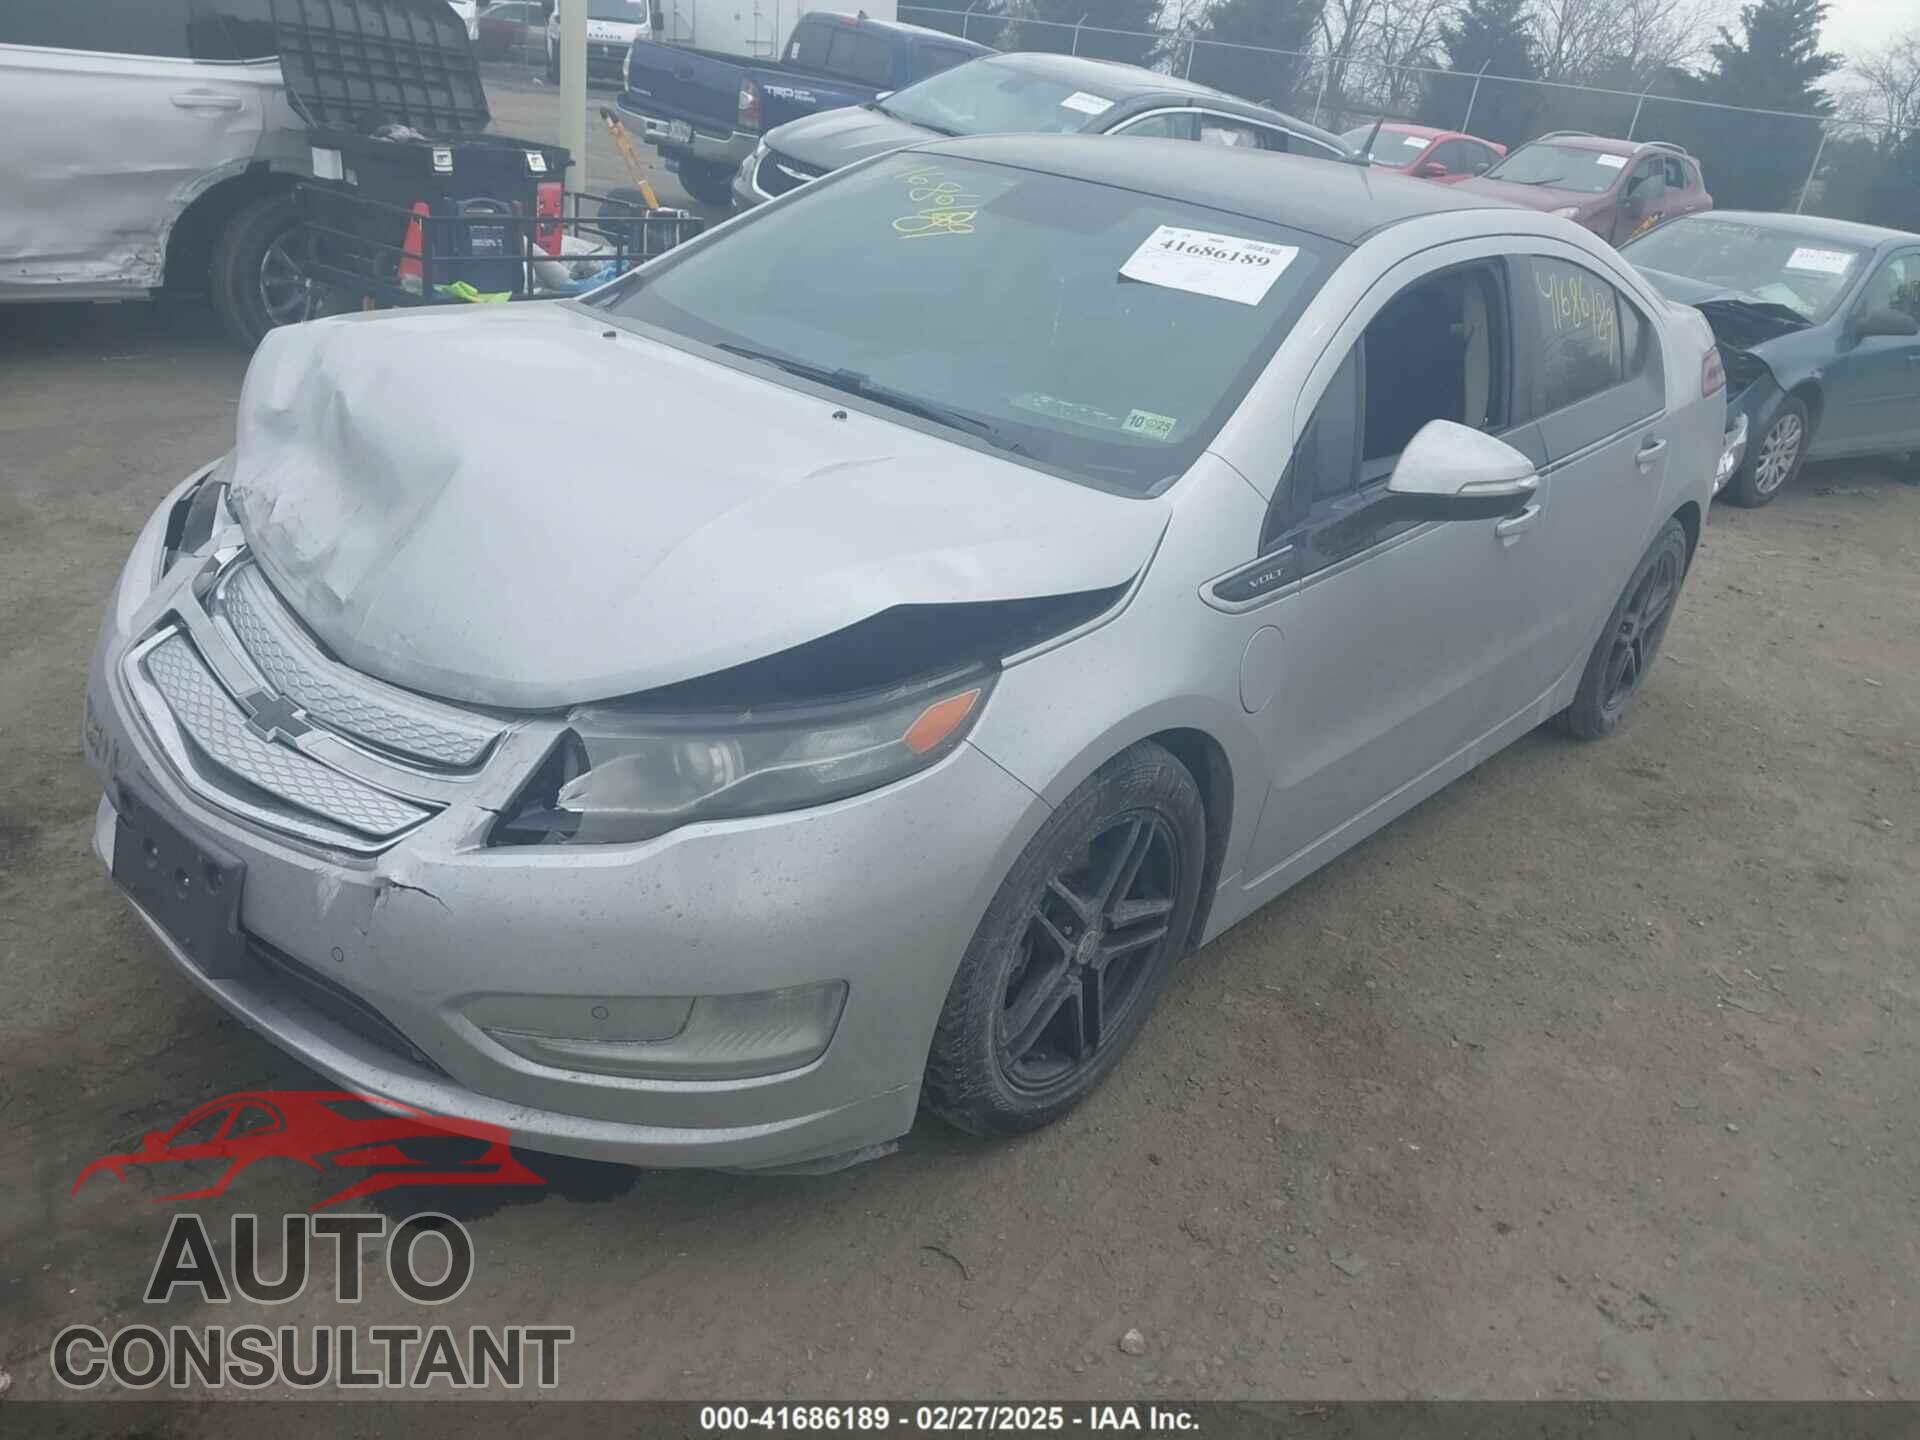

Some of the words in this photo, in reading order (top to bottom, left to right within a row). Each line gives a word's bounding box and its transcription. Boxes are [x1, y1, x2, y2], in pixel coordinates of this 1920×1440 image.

[1160, 238, 1272, 267] 41686189
[1129, 414, 1145, 428] 10
[1249, 567, 1284, 588] VOLT
